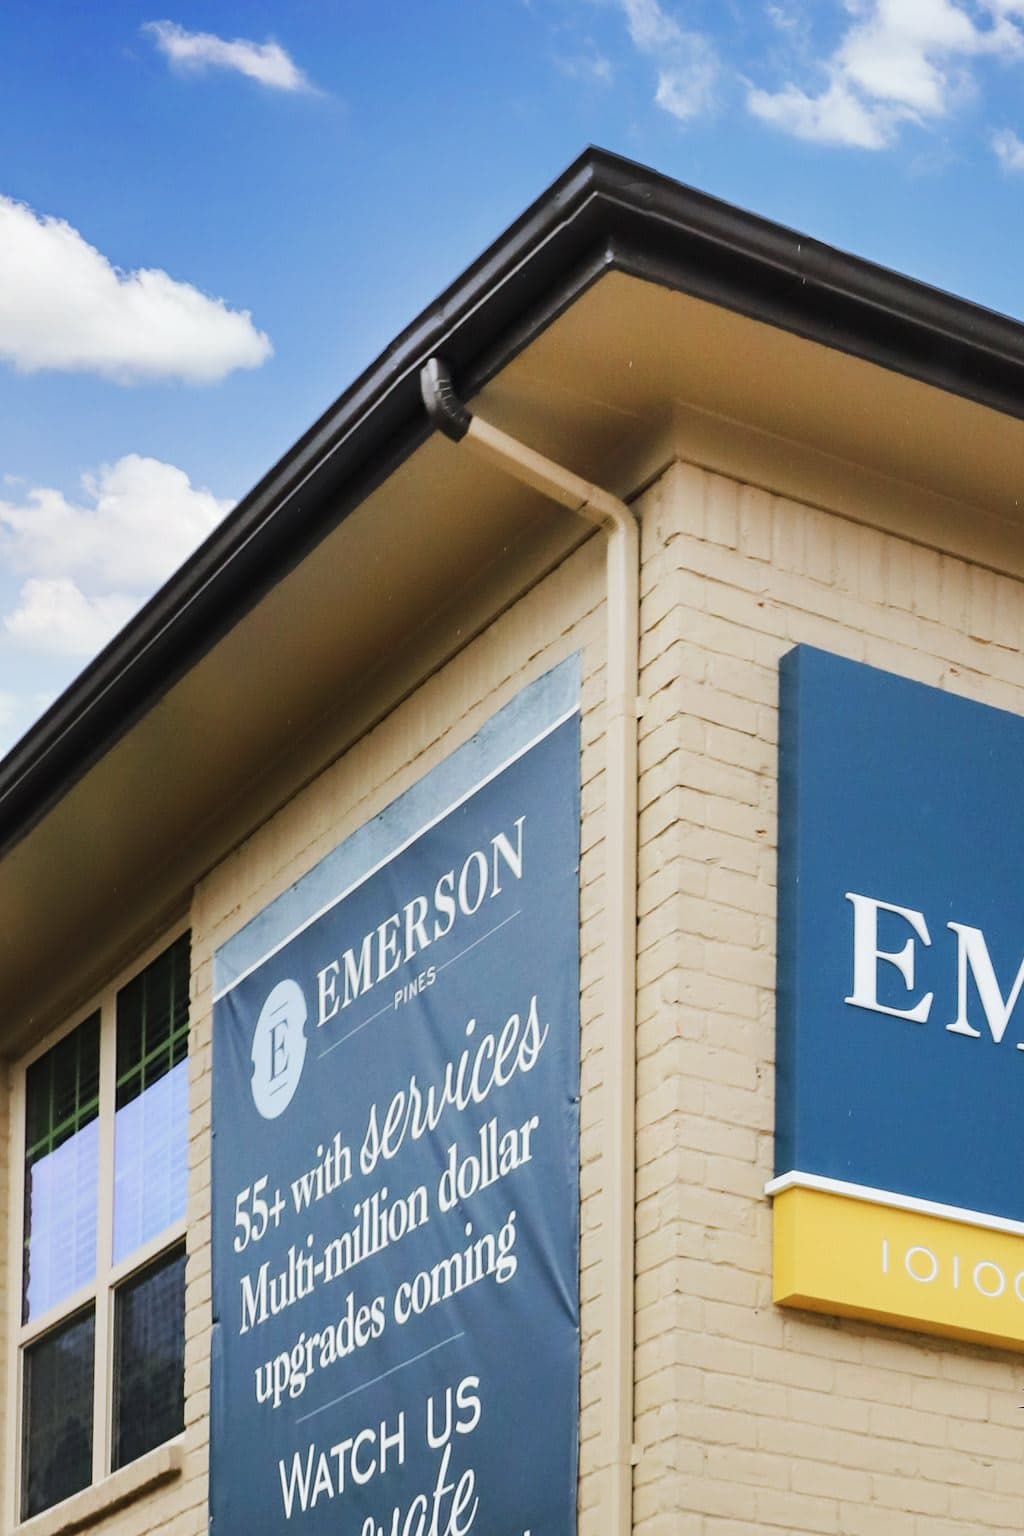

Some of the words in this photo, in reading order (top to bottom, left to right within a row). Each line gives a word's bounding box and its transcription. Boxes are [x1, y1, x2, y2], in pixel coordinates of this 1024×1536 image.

[316, 815, 526, 1028] EMERSON
[393, 966, 437, 1009] PINES
[233, 1174, 286, 1253] 55+
[291, 1131, 352, 1214] with
[359, 994, 549, 1175] services
[268, 1018, 290, 1083] E
[239, 1186, 430, 1336] Multi-million
[438, 1115, 539, 1212] dollar
[254, 1292, 386, 1409] upgrades
[393, 1210, 518, 1325] coming
[278, 1411, 406, 1519] WATCH
[426, 1375, 481, 1449] US
